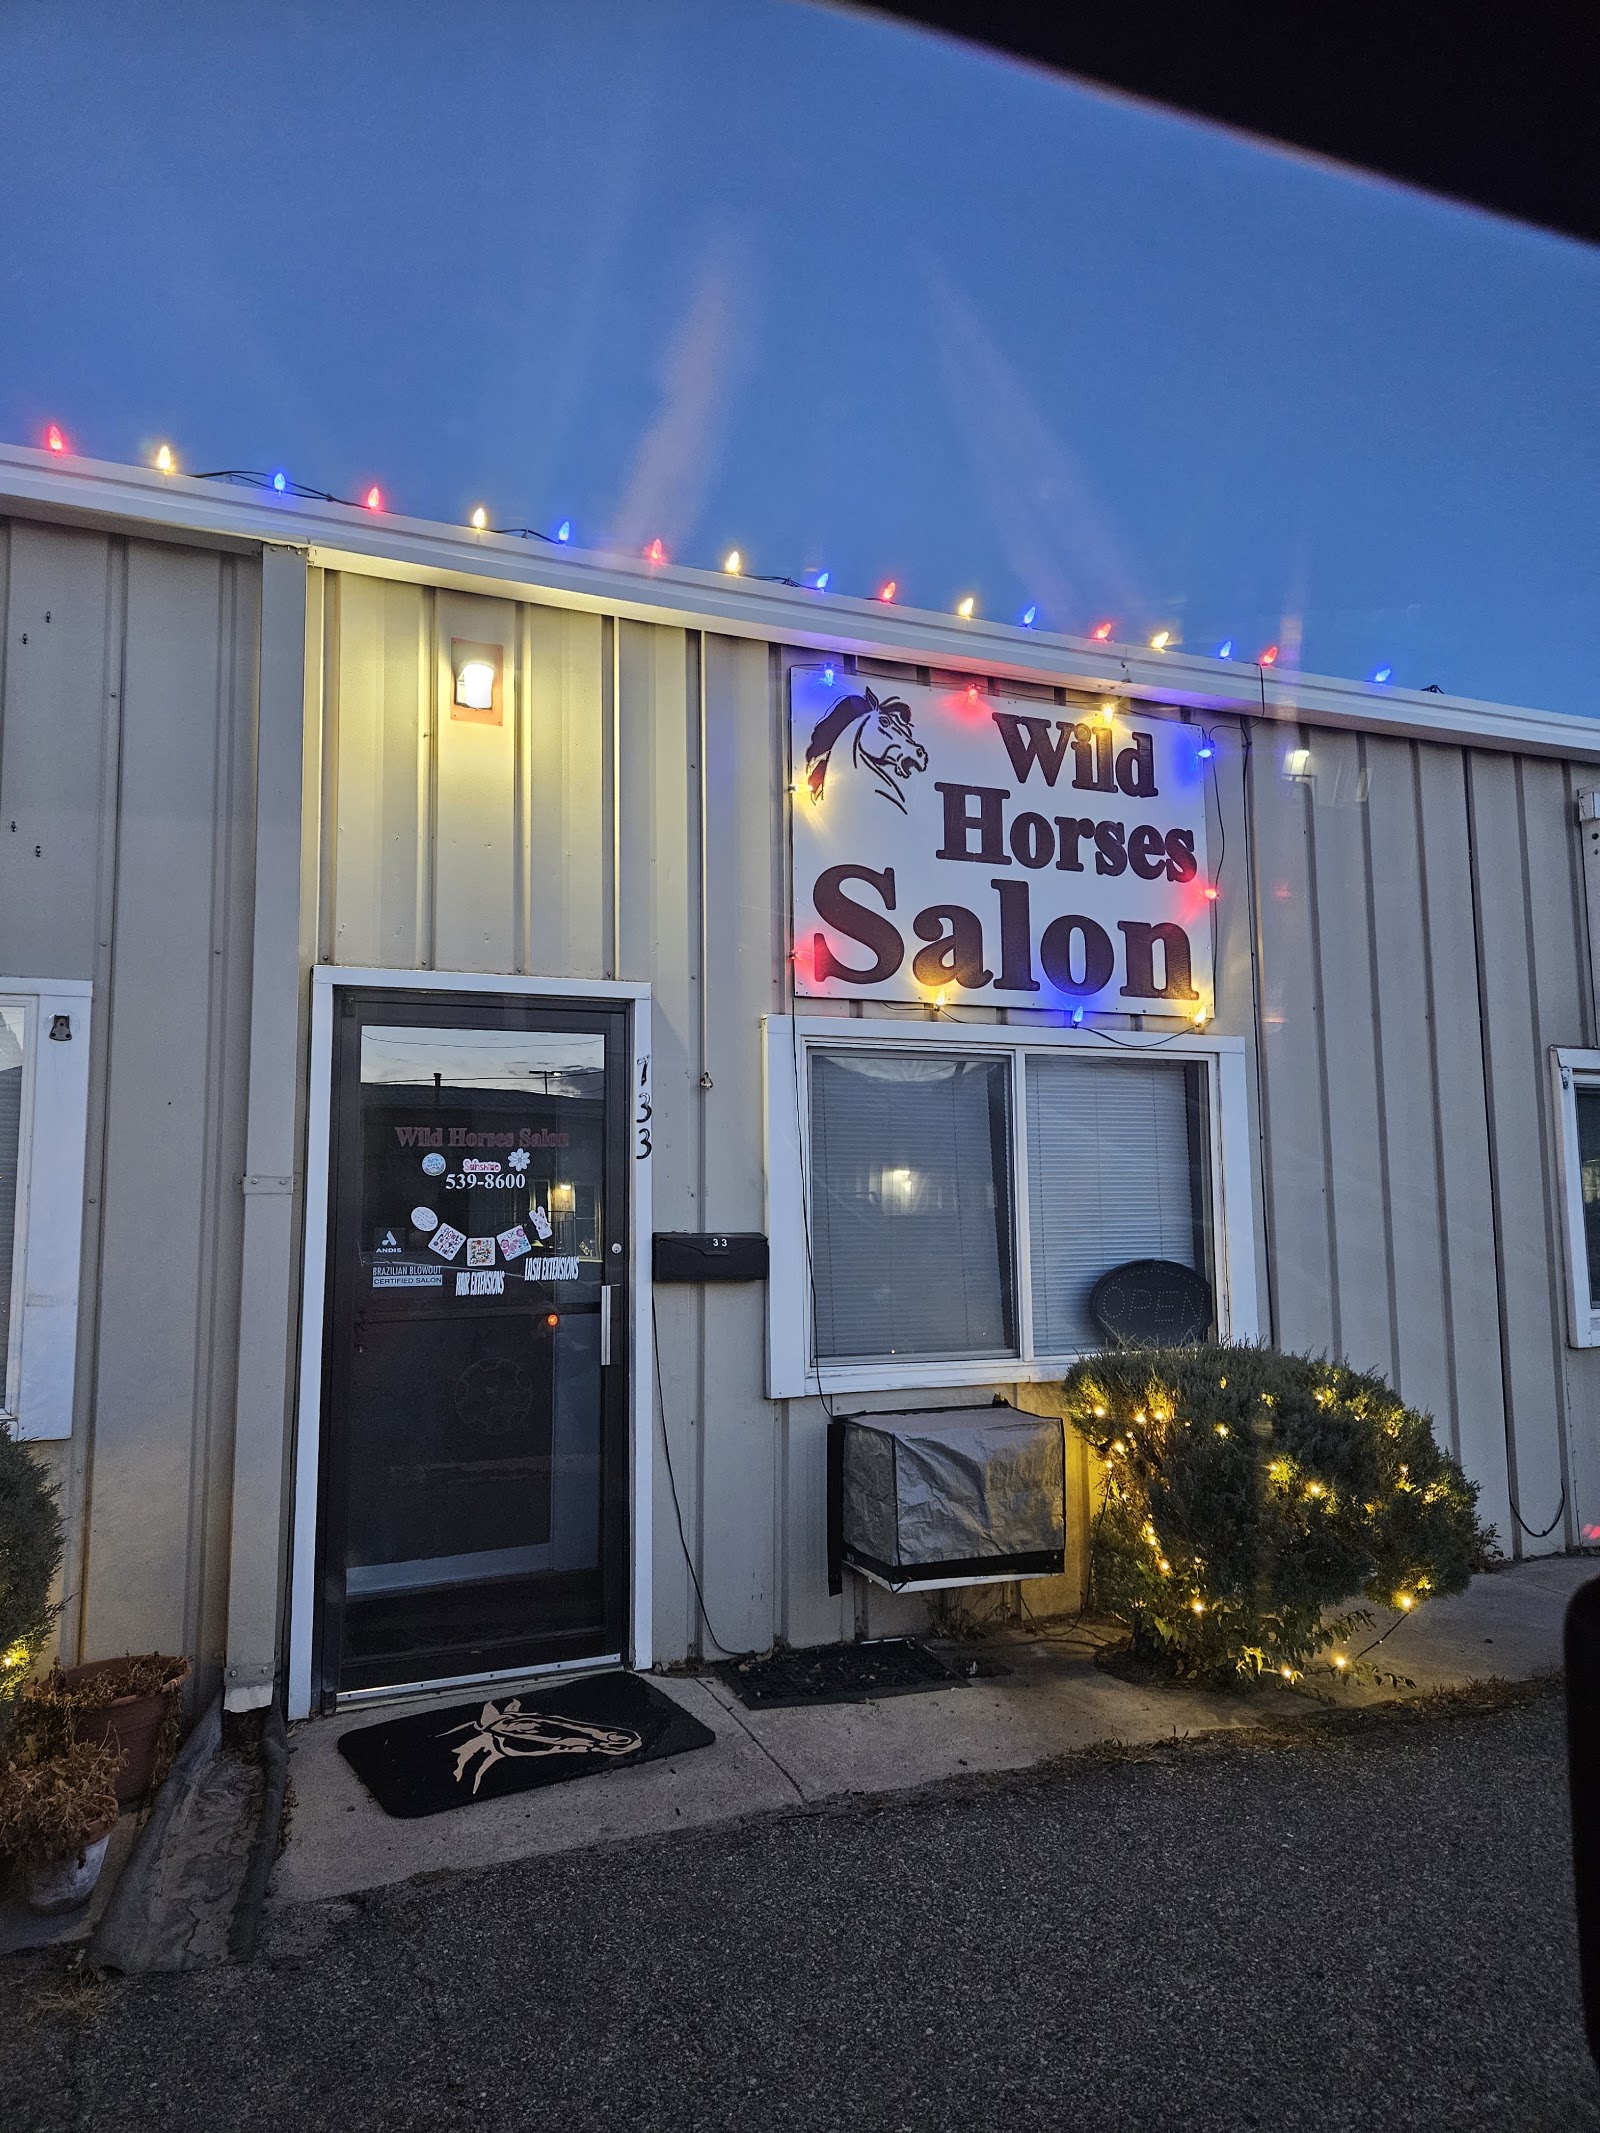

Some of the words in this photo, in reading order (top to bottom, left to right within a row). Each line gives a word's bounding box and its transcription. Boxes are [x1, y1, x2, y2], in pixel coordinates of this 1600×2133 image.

[992, 712, 1159, 798] Wild
[934, 781, 1198, 883] Horses
[812, 863, 1200, 1000] Salon
[636, 1055, 652, 1159] 733
[395, 1126, 443, 1147] Wild
[448, 1127, 514, 1148] Horses
[519, 1127, 570, 1148] Salon
[445, 1173, 525, 1190] 539-8600
[712, 1238, 728, 1247] 33
[372, 1266, 408, 1276] BRAZILIAN
[409, 1265, 441, 1275] BLOWOUT
[525, 1257, 541, 1281] LASH
[541, 1256, 580, 1281] EXTENSIONS
[456, 1272, 470, 1296] HAIR
[470, 1271, 505, 1295] EXTENSIONS
[1102, 1286, 1207, 1325] OPEN
